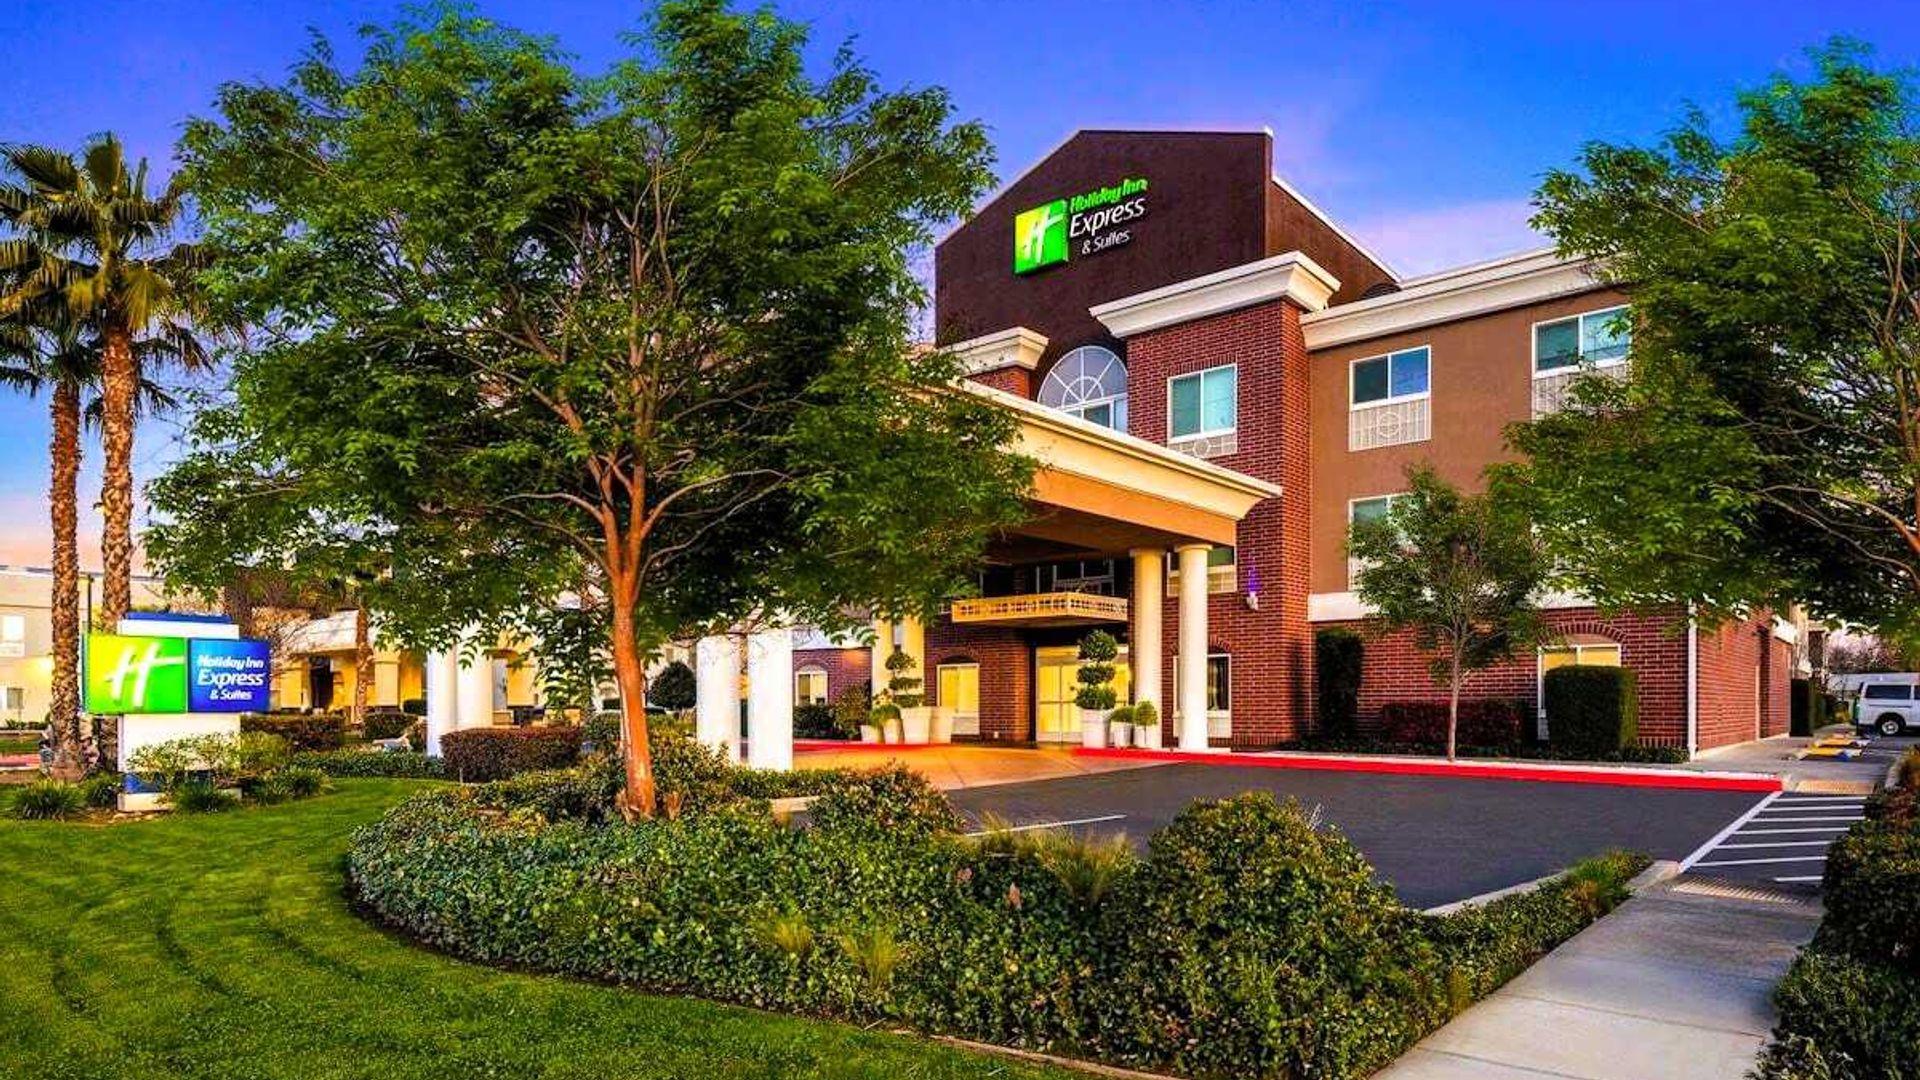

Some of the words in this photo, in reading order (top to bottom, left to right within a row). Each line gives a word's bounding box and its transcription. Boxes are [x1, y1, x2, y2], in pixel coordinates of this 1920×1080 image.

[1070, 185, 1122, 213] Holiday
[1122, 178, 1149, 196] Inn
[1069, 198, 1146, 238] Express
[1081, 239, 1091, 255] &
[1093, 229, 1131, 253] Suites
[198, 655, 245, 670] Holiday
[246, 656, 264, 668] Inn
[198, 669, 265, 688] Express
[210, 690, 219, 700] &
[221, 690, 252, 700] Suites
